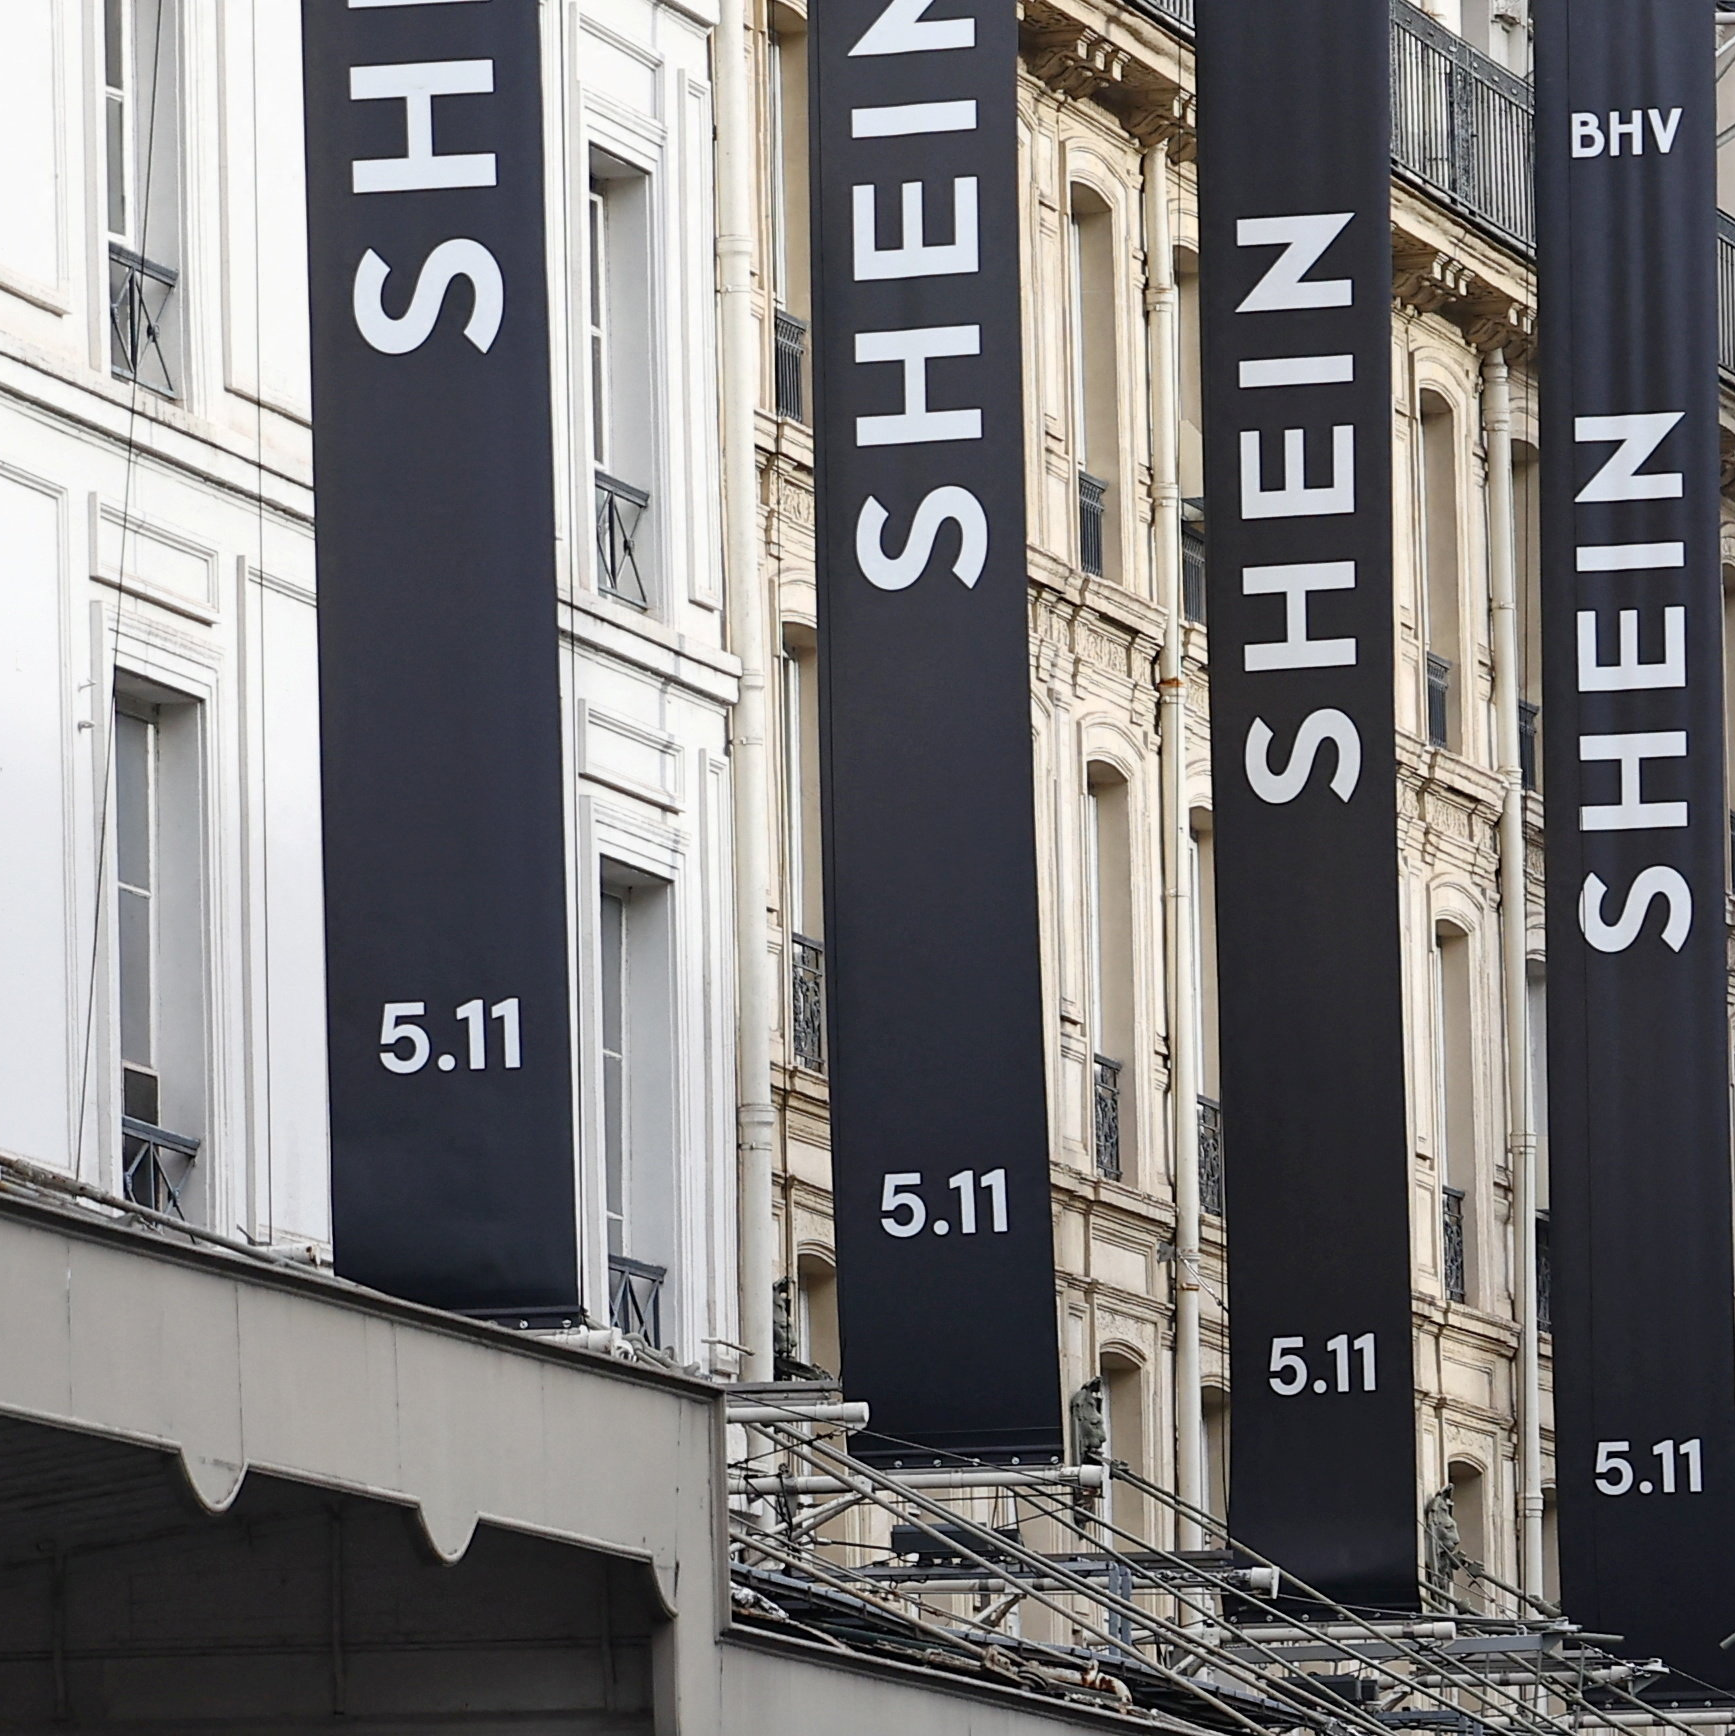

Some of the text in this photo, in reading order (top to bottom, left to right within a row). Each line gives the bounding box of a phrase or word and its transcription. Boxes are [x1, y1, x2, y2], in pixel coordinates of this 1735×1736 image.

[1572, 108, 1682, 157] BHV
[1236, 213, 1360, 803] SHEIN
[1575, 412, 1691, 952] SHEIN
[380, 998, 520, 1073] 5.11
[882, 1169, 1007, 1237] 5.11
[1270, 1334, 1375, 1395] 5.11
[1596, 1439, 1701, 1495] 5.11
